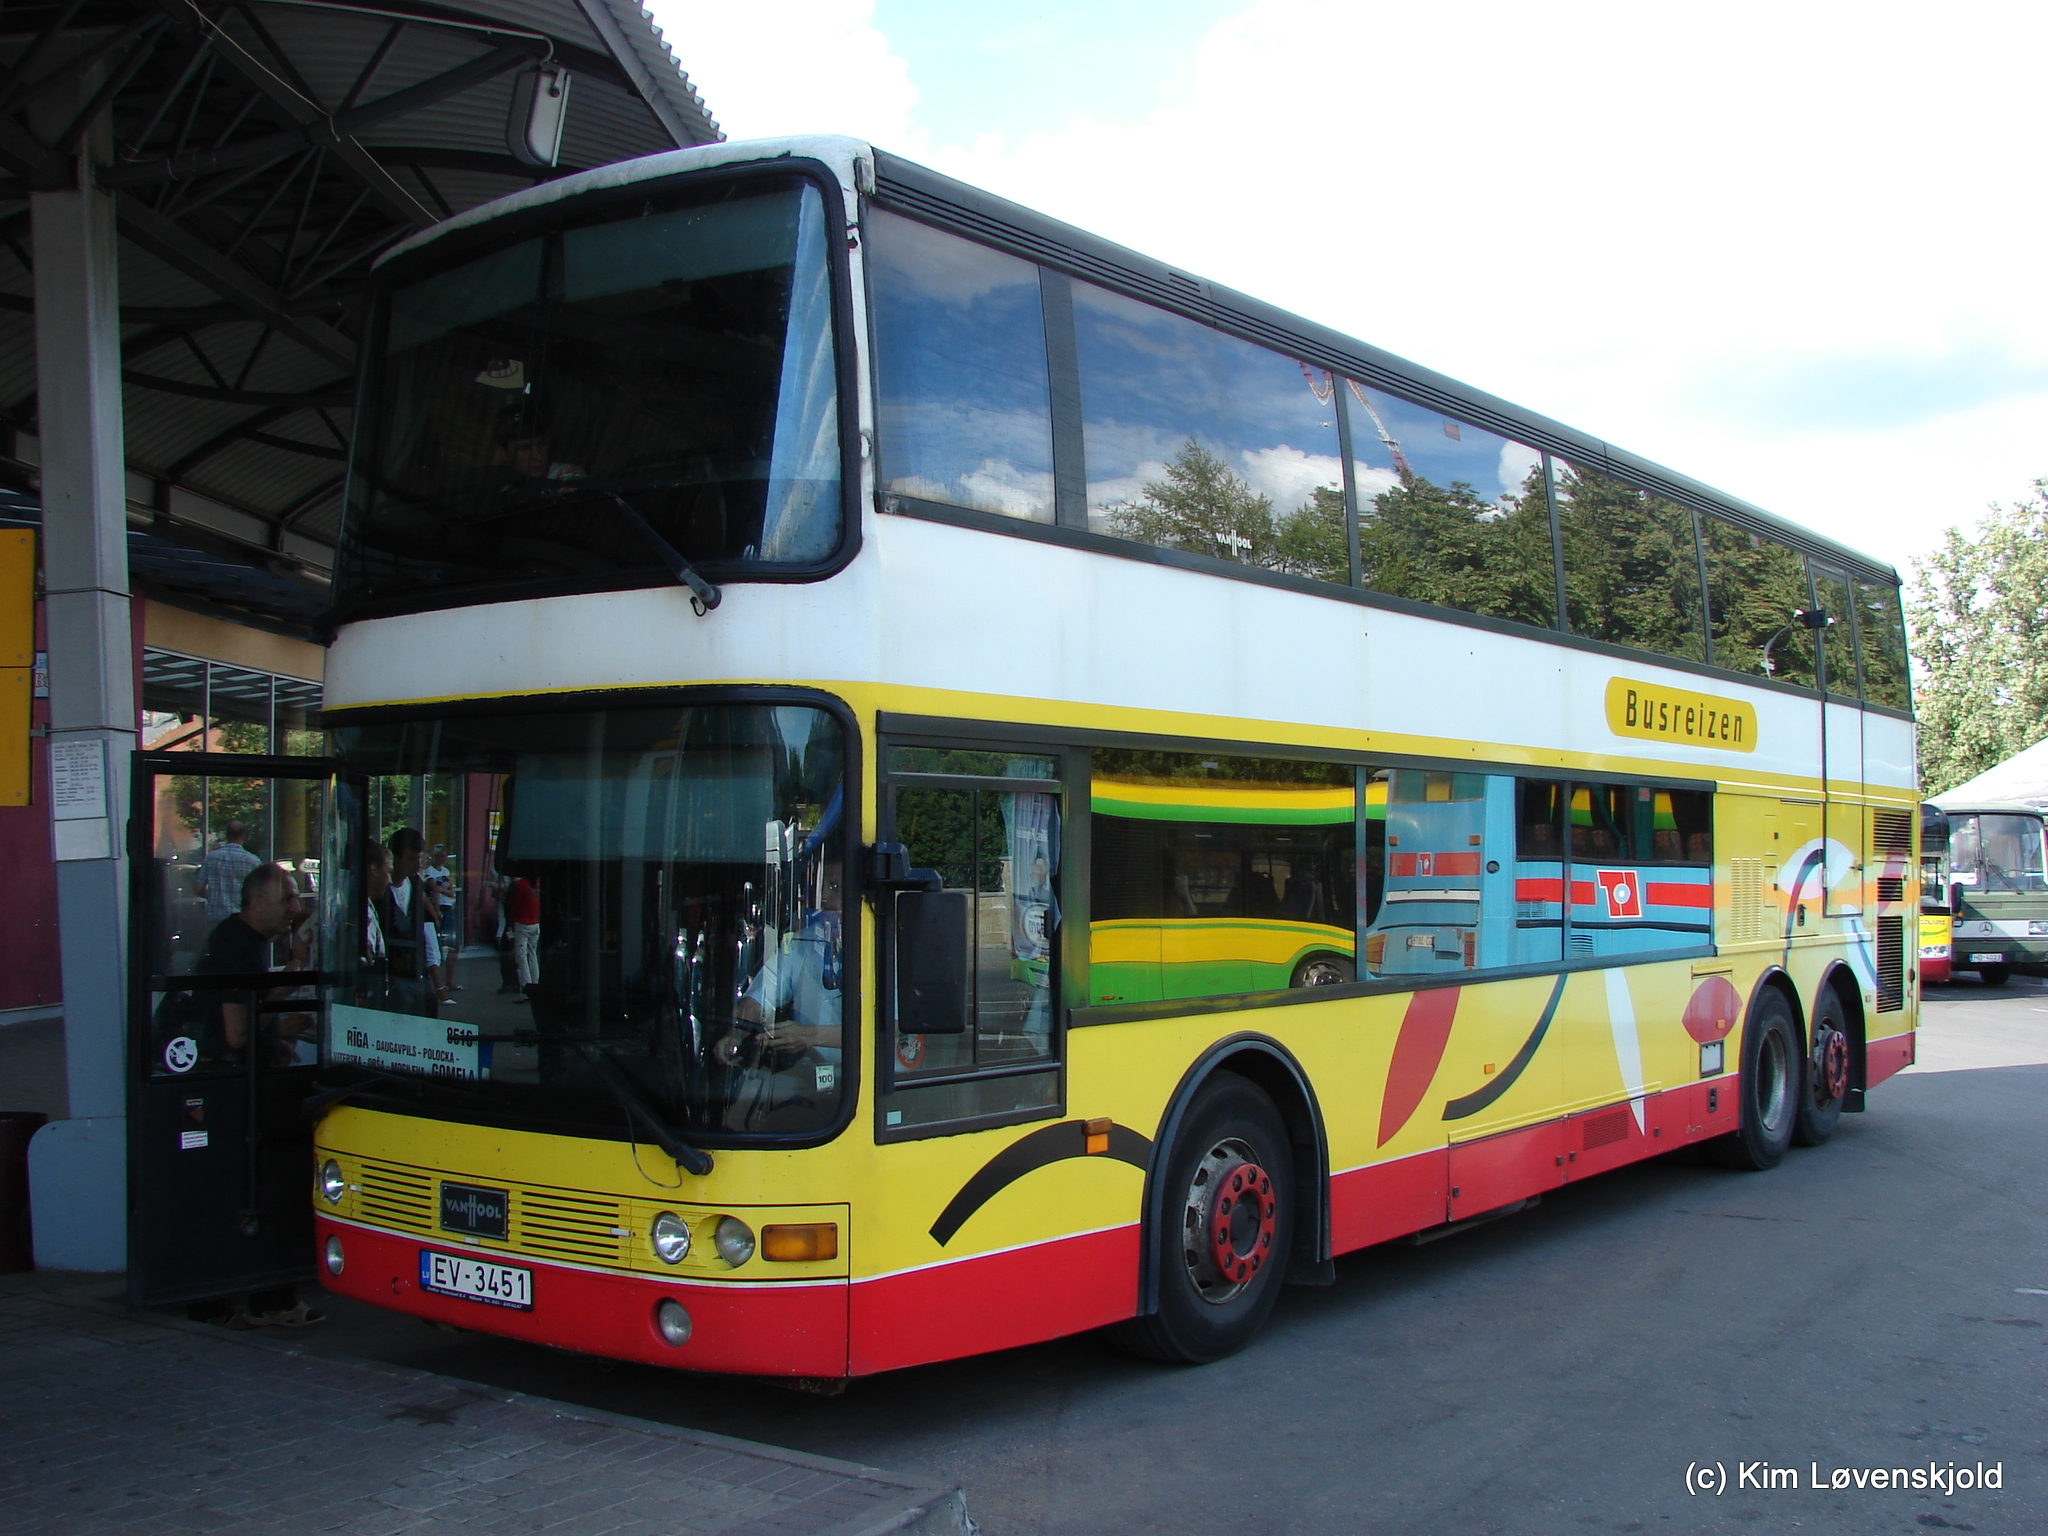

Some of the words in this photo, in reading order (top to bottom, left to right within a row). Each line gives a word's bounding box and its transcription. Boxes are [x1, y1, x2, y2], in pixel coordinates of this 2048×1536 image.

[1625, 689, 1742, 743] Busreizen
[346, 1026, 370, 1049] RĪGA
[375, 1039, 417, 1057] DAUGAVPILS
[422, 1047, 455, 1064] POLOCKA
[818, 1074, 833, 1084] 100
[422, 1270, 430, 1279] LV
[434, 1256, 525, 1300] EV-3451
